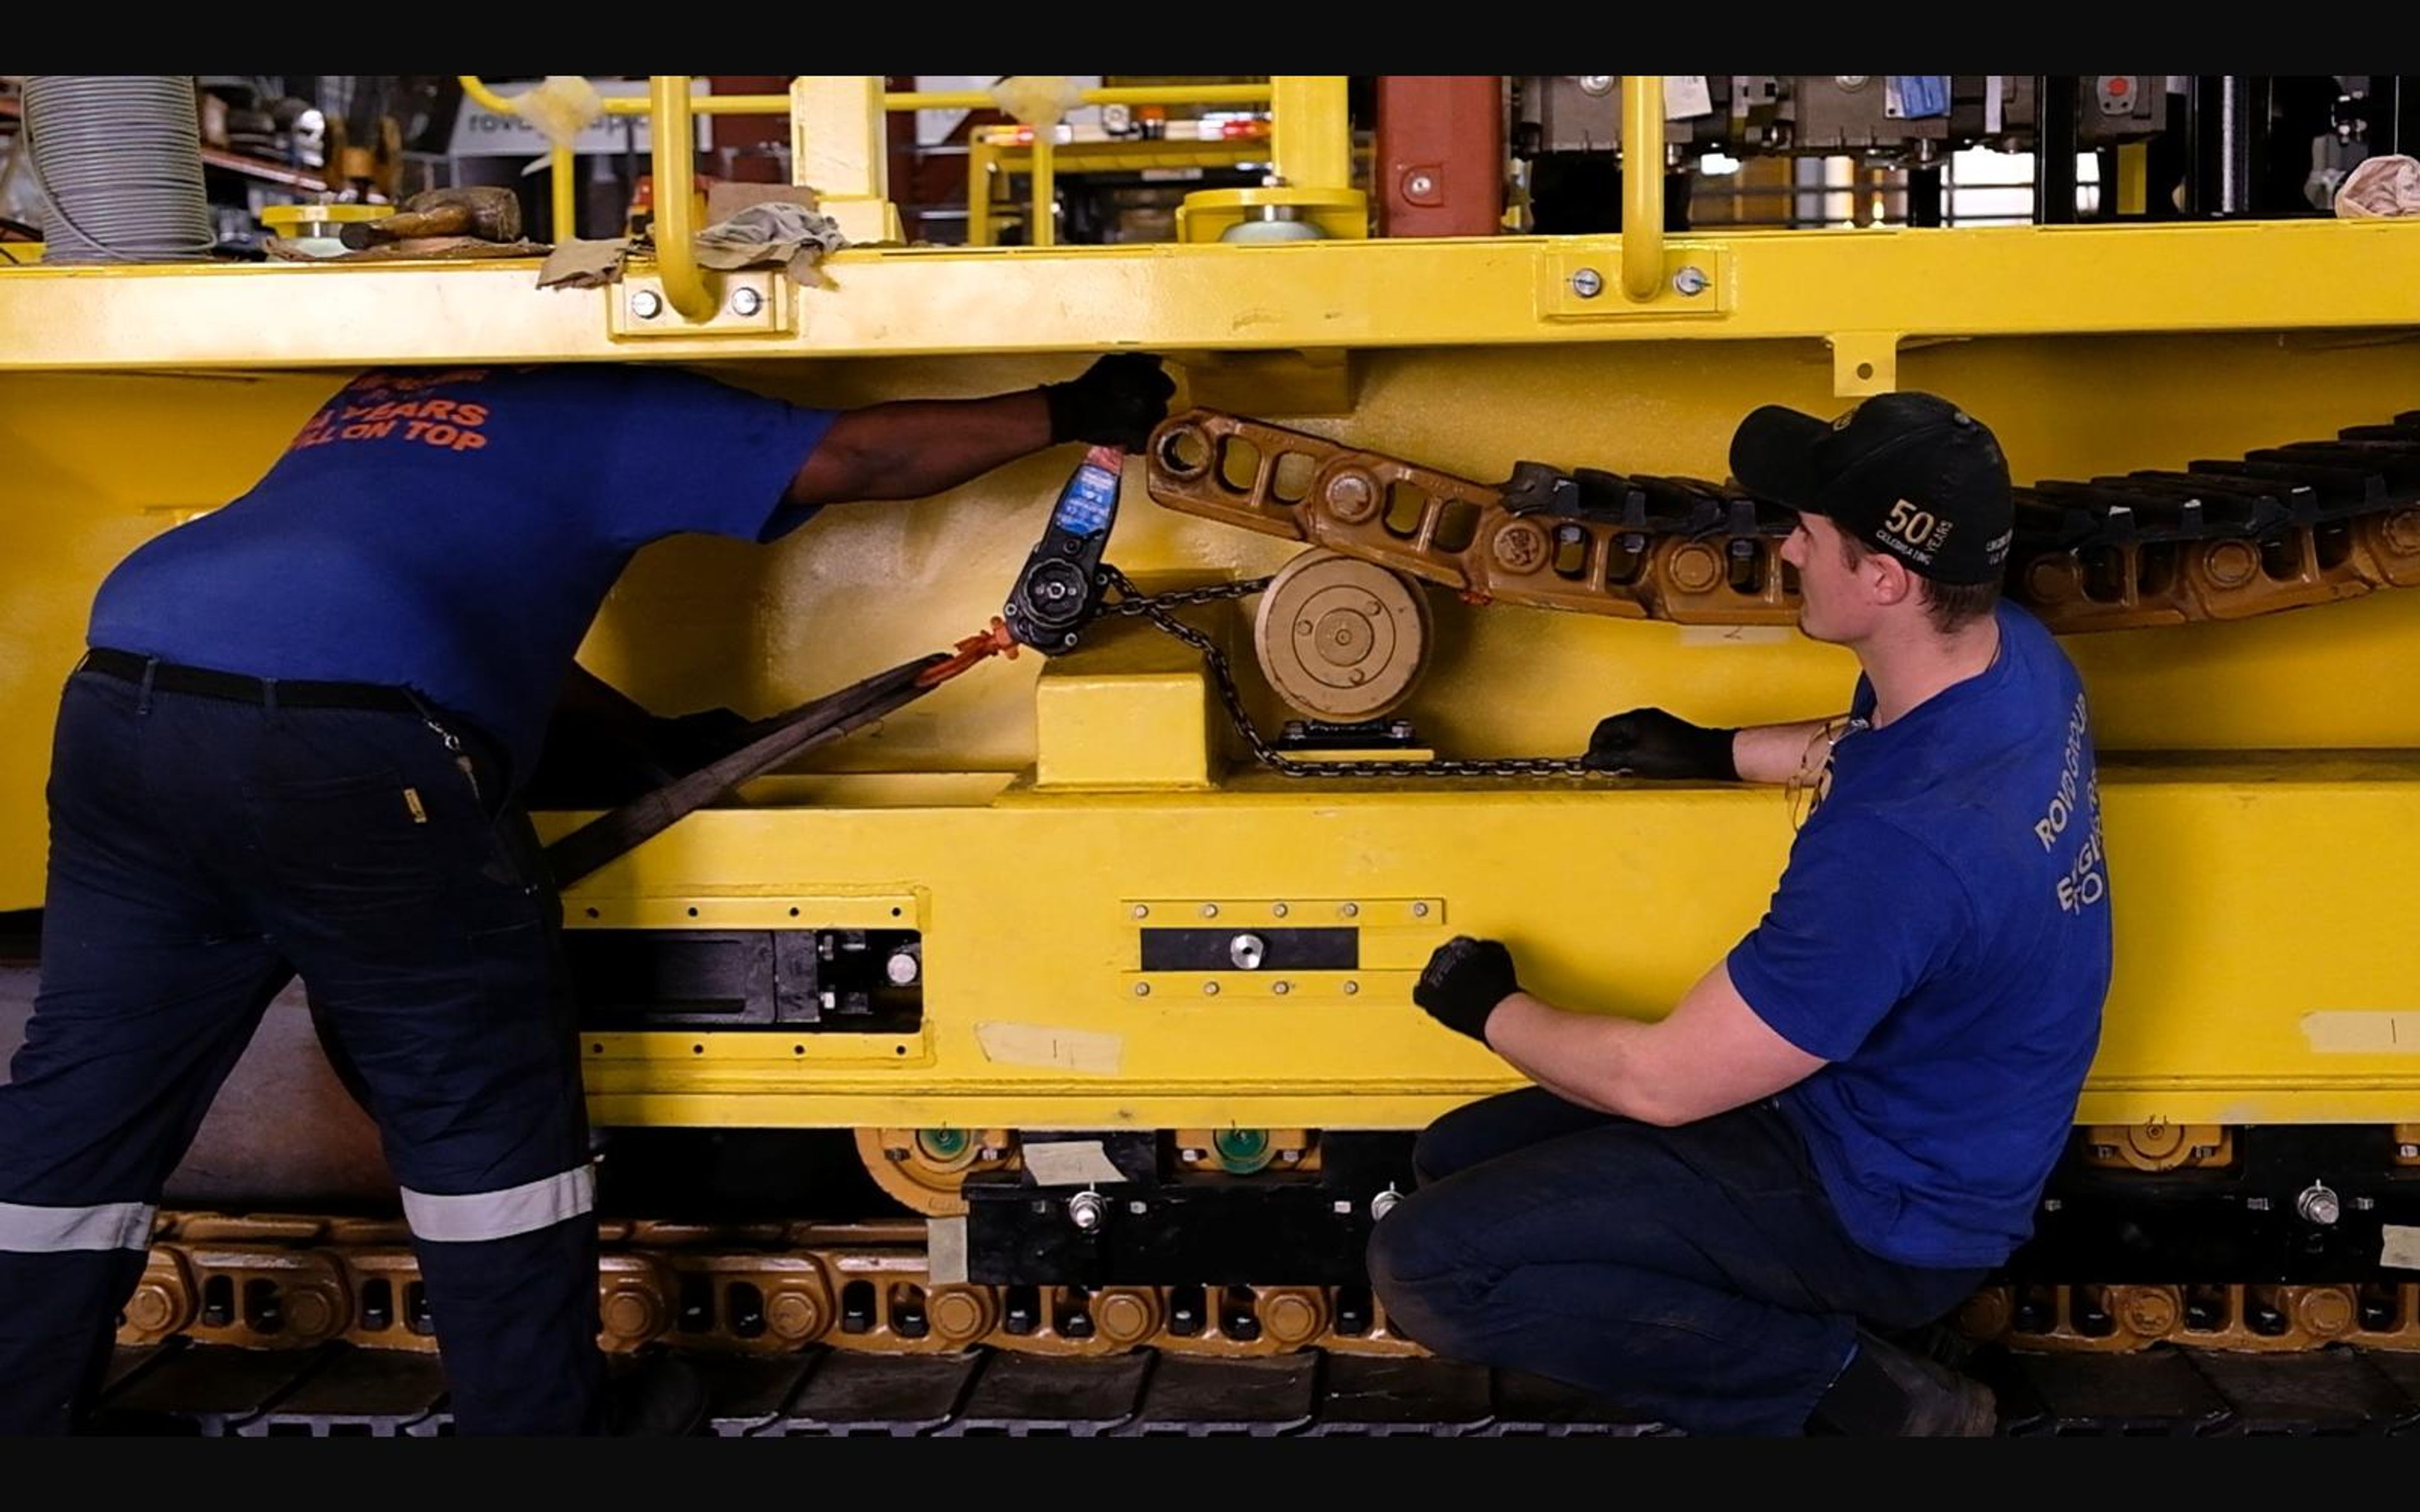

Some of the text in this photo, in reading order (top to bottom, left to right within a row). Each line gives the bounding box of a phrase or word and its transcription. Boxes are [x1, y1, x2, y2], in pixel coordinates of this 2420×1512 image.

[341, 399, 488, 427] YEARS
[342, 420, 397, 439] ON
[405, 420, 487, 450] TOP
[1885, 498, 1935, 544] 50
